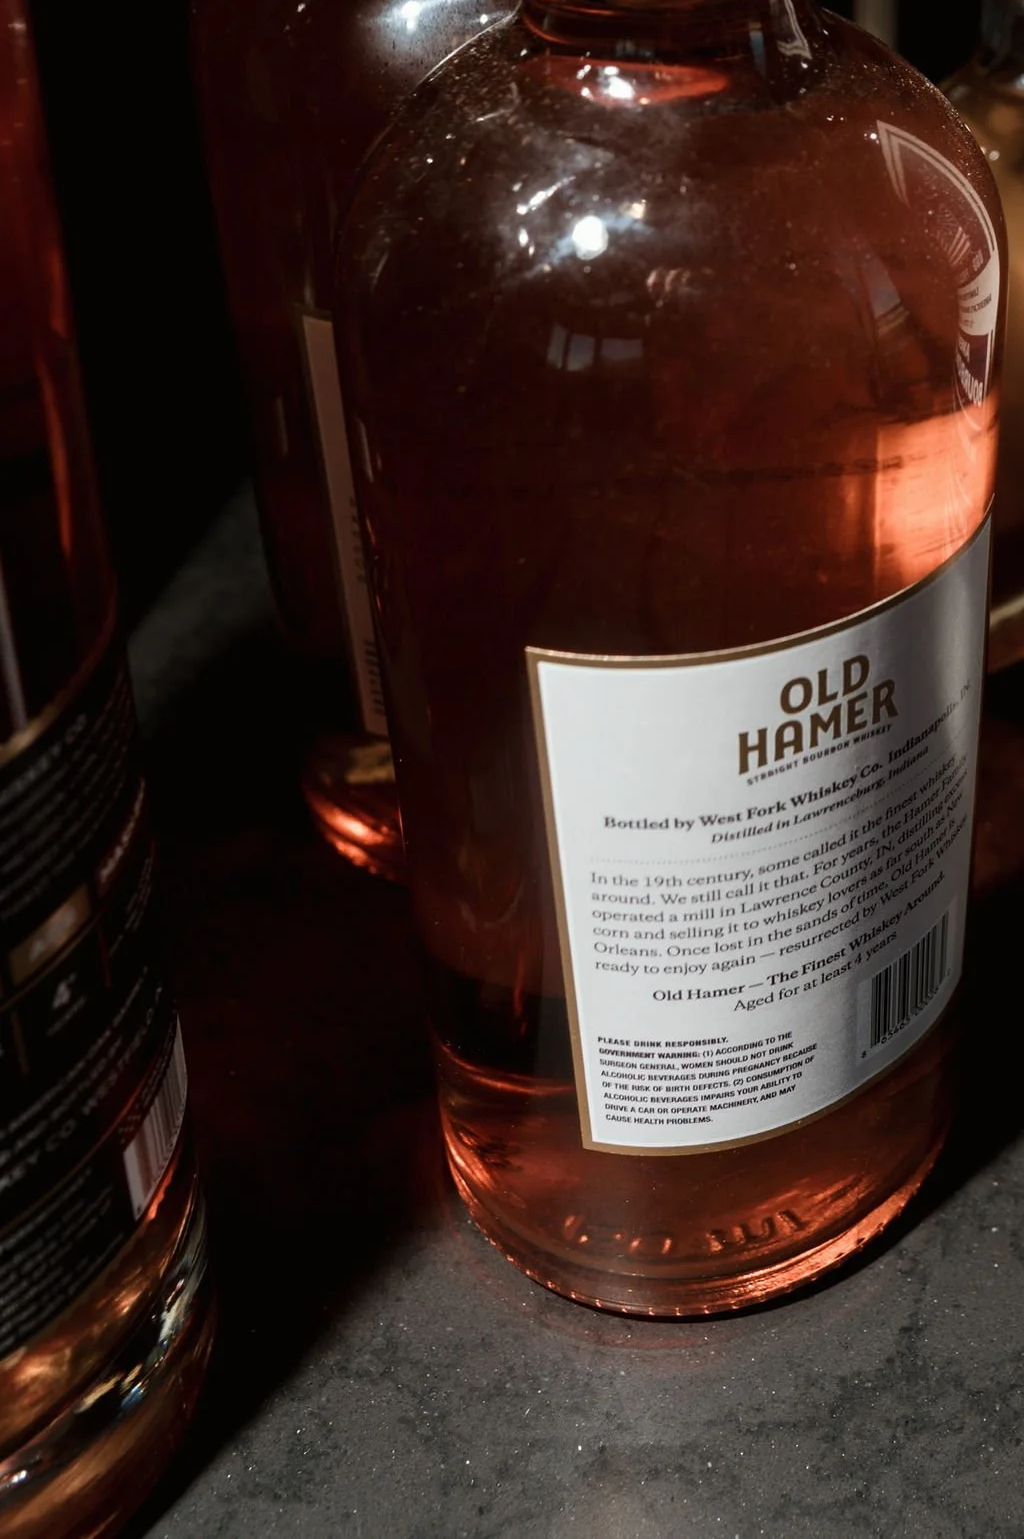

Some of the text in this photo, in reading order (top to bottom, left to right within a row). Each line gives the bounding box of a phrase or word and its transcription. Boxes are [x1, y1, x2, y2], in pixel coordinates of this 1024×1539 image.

[780, 654, 870, 714] OLD
[738, 679, 899, 775] HAMER
[747, 723, 893, 786] STRAIGHT BOURBON WHISKEY
[604, 763, 883, 832] Bottled by West Fork Whiskey Co.
[711, 746, 929, 845] Distilled in Lawrenceburg, Indiana
[590, 793, 919, 888] In the 19th century, some called it the finest
[591, 789, 939, 906] around. We still call it that. For years, the Hamer
[592, 801, 943, 924] operated mill in Lawrence County, IN, distilling
[593, 828, 934, 941] corn and selling it to whiskey lovers as far south
[594, 827, 949, 958] Orleans. Once lost in the sands of time, Old Hamer
[595, 861, 935, 976] ready to enjoy again resurrected by West Fork
[652, 870, 946, 1001] Old Hamer The Finest Whiskey Around.
[734, 931, 898, 1011] Aged for at least years
[597, 1036, 631, 1047] PLEASE
[665, 1036, 729, 1048] RESPONSIBLY.
[598, 1031, 793, 1059] GOVERNMENT WARNING: ACCORDING TO THE
[599, 1041, 794, 1071] SURGEON GENERAL, WOMEN SHOULD NOT DRINK
[601, 1042, 818, 1082] ALCOHOLIC BEVERAGES DURING PREGNANCY BECAUSE
[603, 1076, 791, 1103] ALCOHOLIC BEVERAGES IMPAIRS YOUR ABILITY
[604, 1103, 628, 1112] DRIVE
[670, 1105, 708, 1114] OPERATE
[709, 1097, 759, 1111] MACHINERY,
[760, 1091, 777, 1101] AND
[779, 1084, 797, 1096] MAY
[631, 1061, 803, 1093] RISK BIRTH DEFECTS. CONSUMPTION
[605, 1114, 714, 1125] CAUSE HEALTH PROBLEMS.
